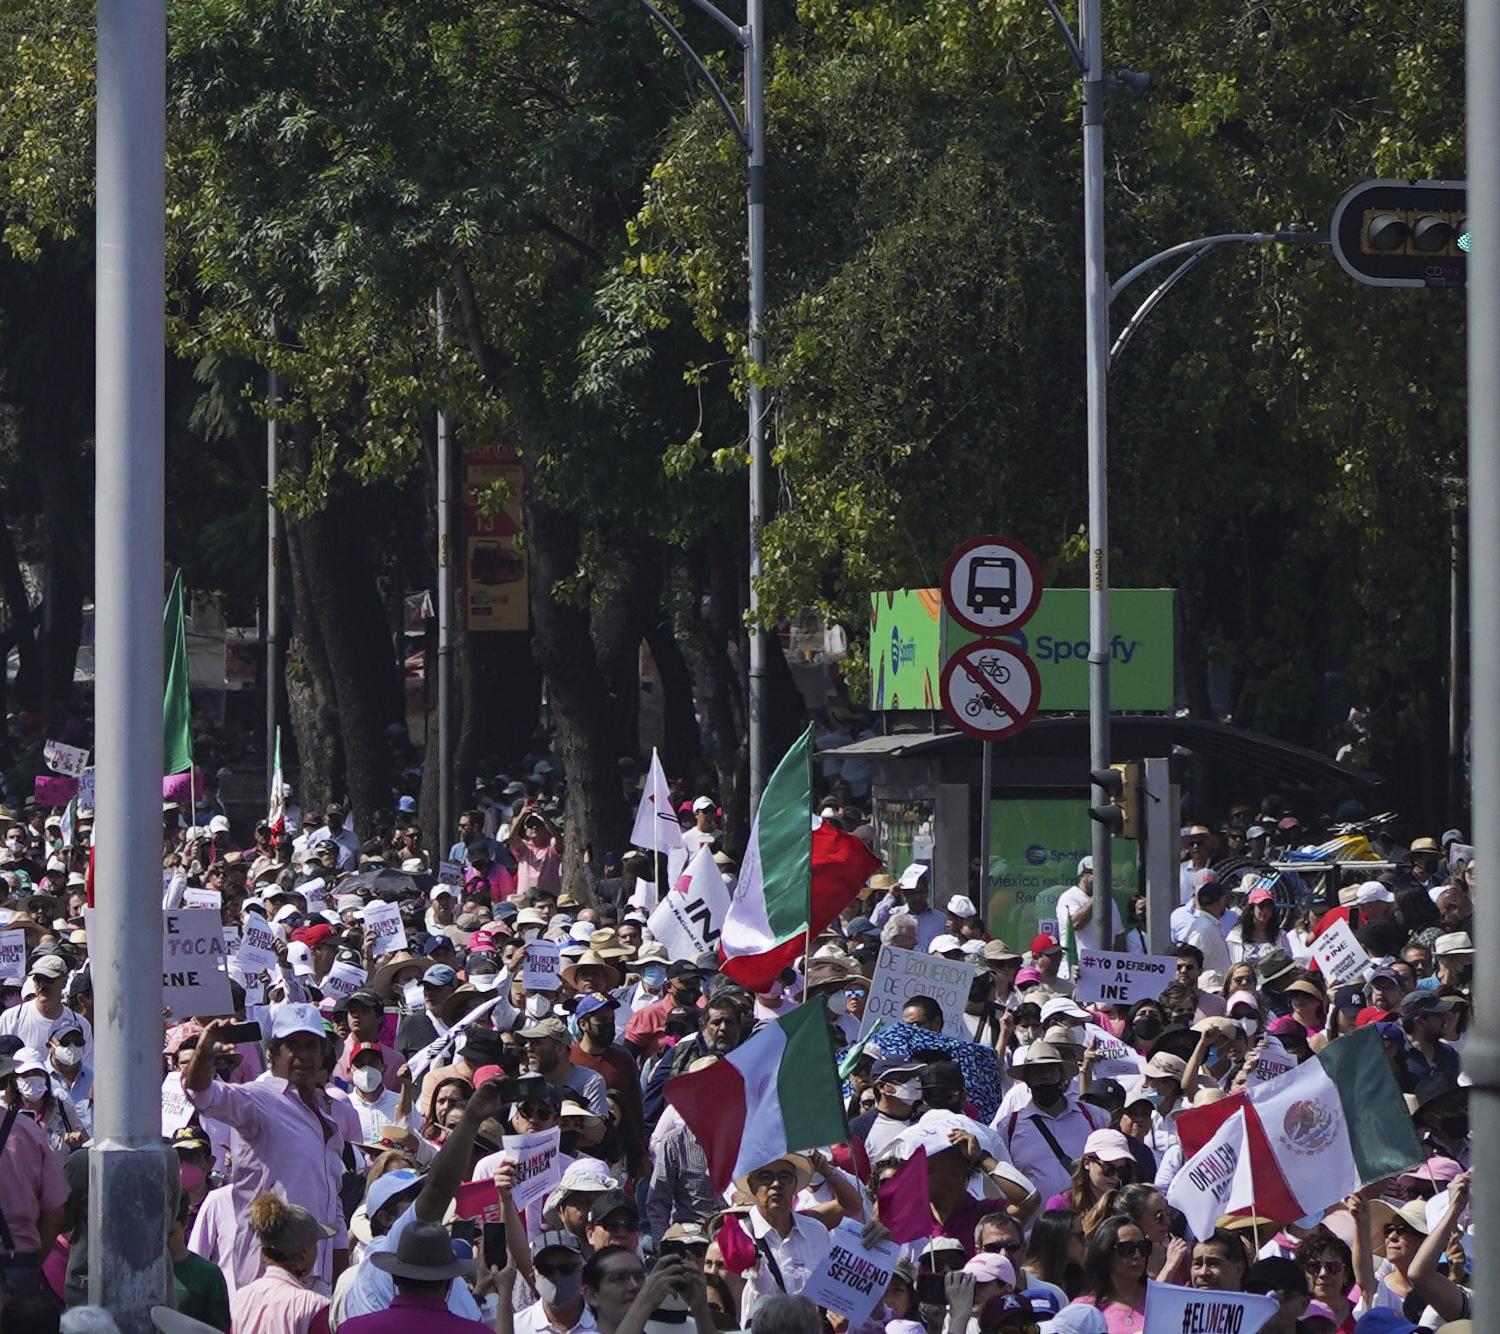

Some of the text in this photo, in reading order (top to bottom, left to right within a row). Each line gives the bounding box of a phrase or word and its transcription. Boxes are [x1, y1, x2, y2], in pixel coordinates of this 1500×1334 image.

[169, 937, 224, 956] TOCA
[1330, 939, 1349, 958] INE
[528, 964, 560, 975] #ELINENO
[529, 973, 555, 984] SETOCA
[1115, 971, 1132, 984] AL
[883, 976, 901, 995] DE
[1100, 984, 1129, 1001] INE
[827, 1244, 889, 1288] #ELINENO
[827, 1263, 872, 1296] SETOCA
